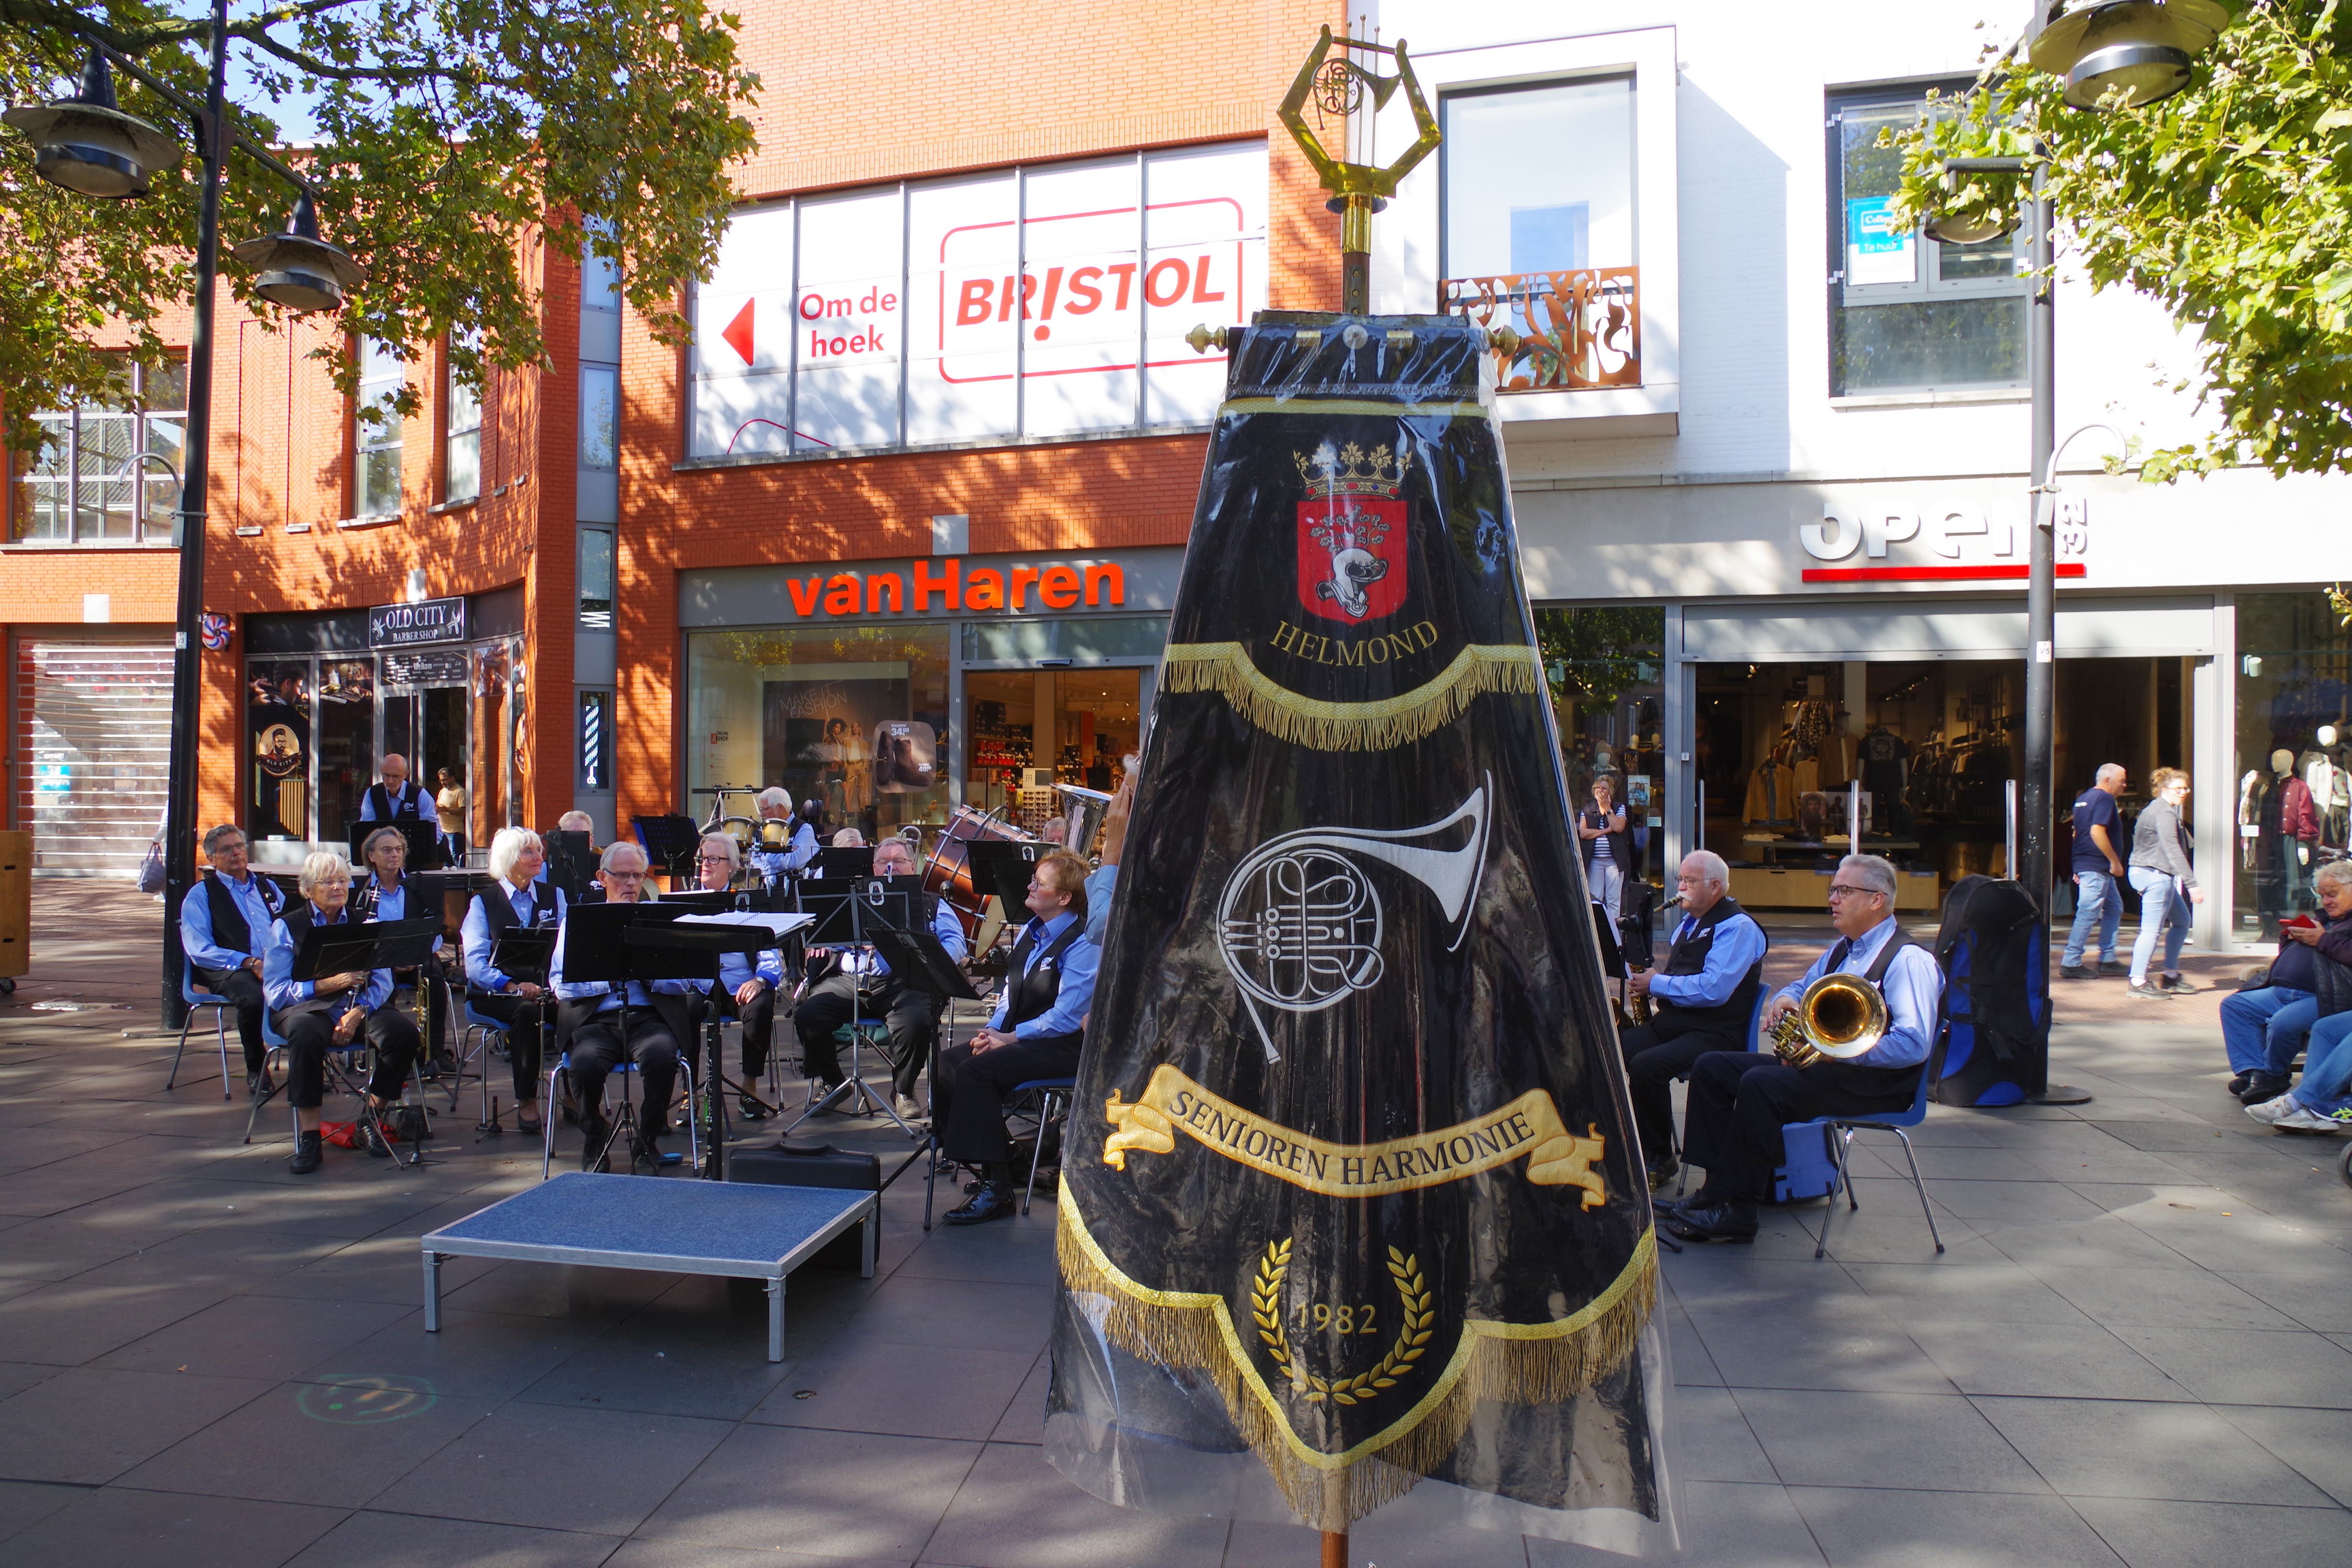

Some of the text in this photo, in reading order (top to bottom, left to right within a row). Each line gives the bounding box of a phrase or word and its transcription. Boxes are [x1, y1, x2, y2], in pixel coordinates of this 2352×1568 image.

[799, 285, 897, 321] Om de
[811, 324, 885, 358] hoek
[786, 559, 1125, 616] vanHaren
[386, 605, 447, 629] OLD CITY
[393, 629, 438, 642] BARBER SHOP
[1270, 620, 1438, 667] HELMOND
[413, 662, 432, 670] Welkom
[780, 688, 816, 711] MAKE
[279, 758, 292, 766] CITY
[1168, 1090, 1535, 1185] SENIOREN HARMONIE
[1297, 1302, 1377, 1333] 1982
